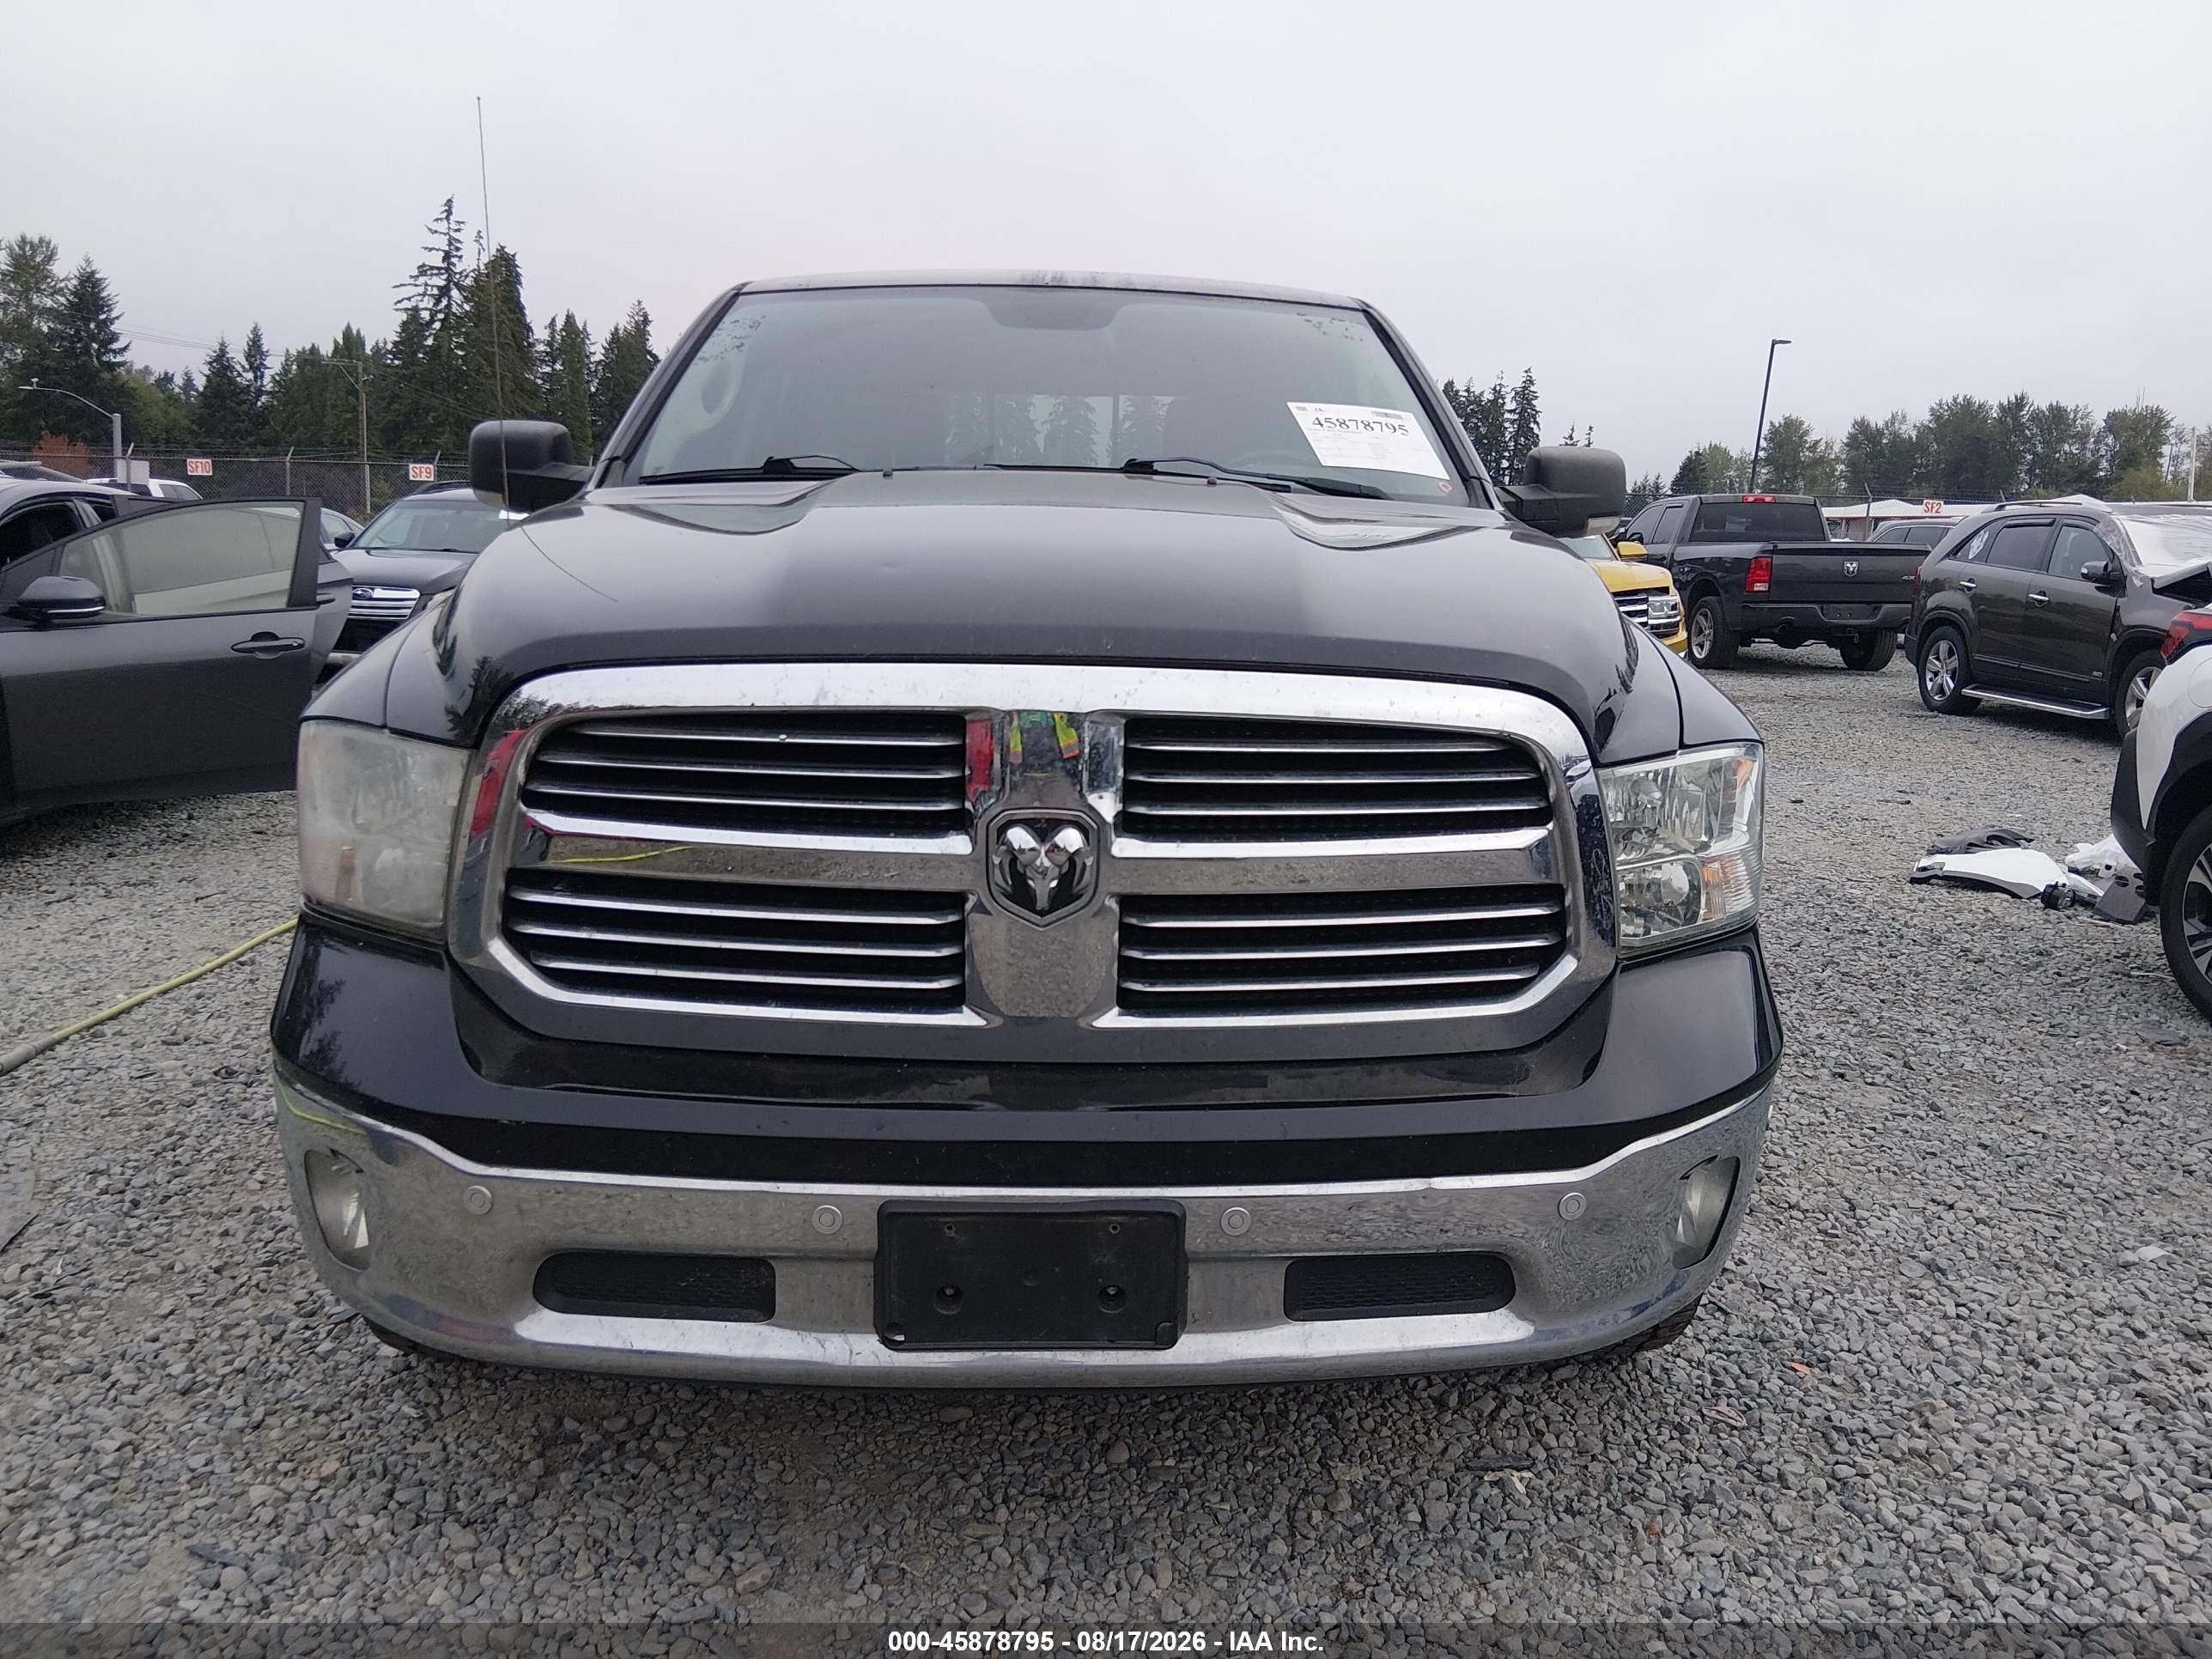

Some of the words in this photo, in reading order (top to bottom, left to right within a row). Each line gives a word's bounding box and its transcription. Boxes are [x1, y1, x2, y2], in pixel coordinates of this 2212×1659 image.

[1312, 416, 1409, 436] 45878795
[188, 460, 211, 473] SF10
[411, 466, 433, 479] SF9
[1923, 501, 1942, 514] SF2
